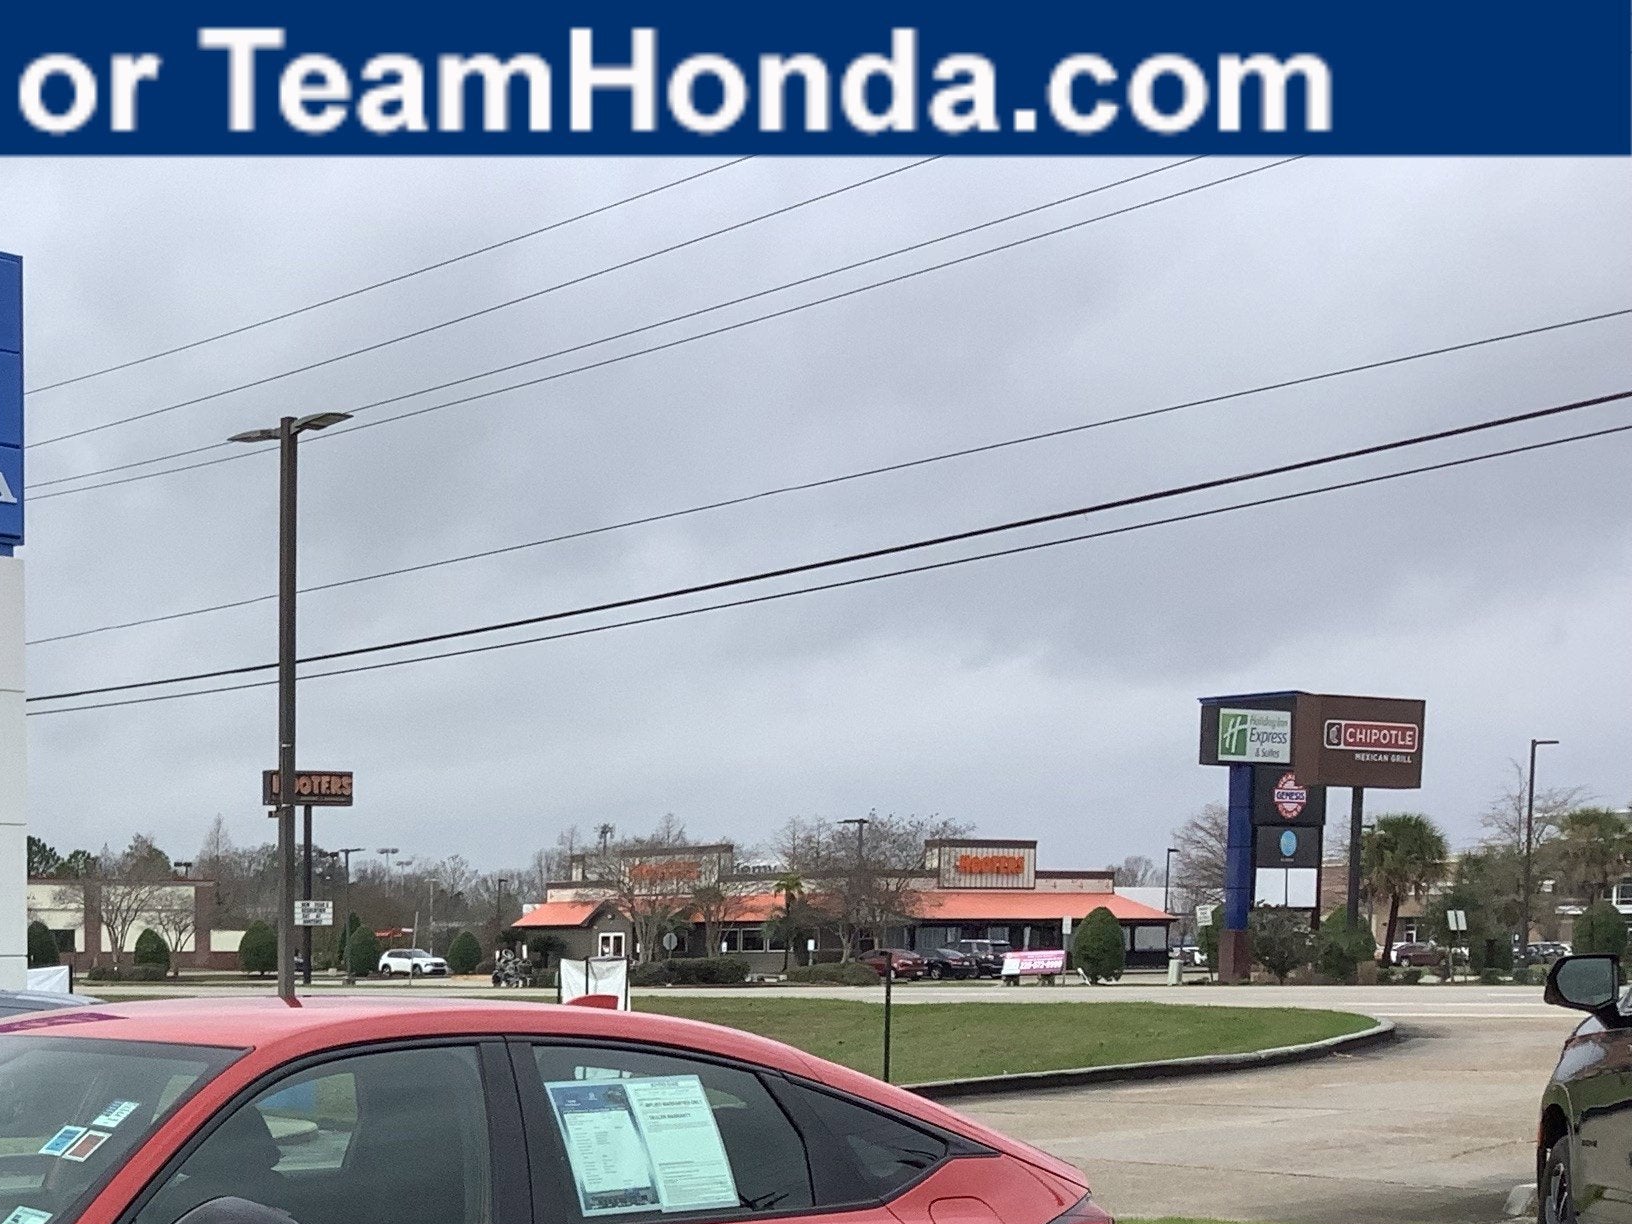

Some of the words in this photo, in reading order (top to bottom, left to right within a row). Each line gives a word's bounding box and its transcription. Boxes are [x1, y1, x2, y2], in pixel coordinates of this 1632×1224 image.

[1249, 727, 1288, 746] Express
[1345, 728, 1414, 745] CHIPOTLE
[1355, 753, 1389, 763] MEXICAN
[1390, 754, 1412, 764] GRILL
[1276, 791, 1305, 800] GENESIS
